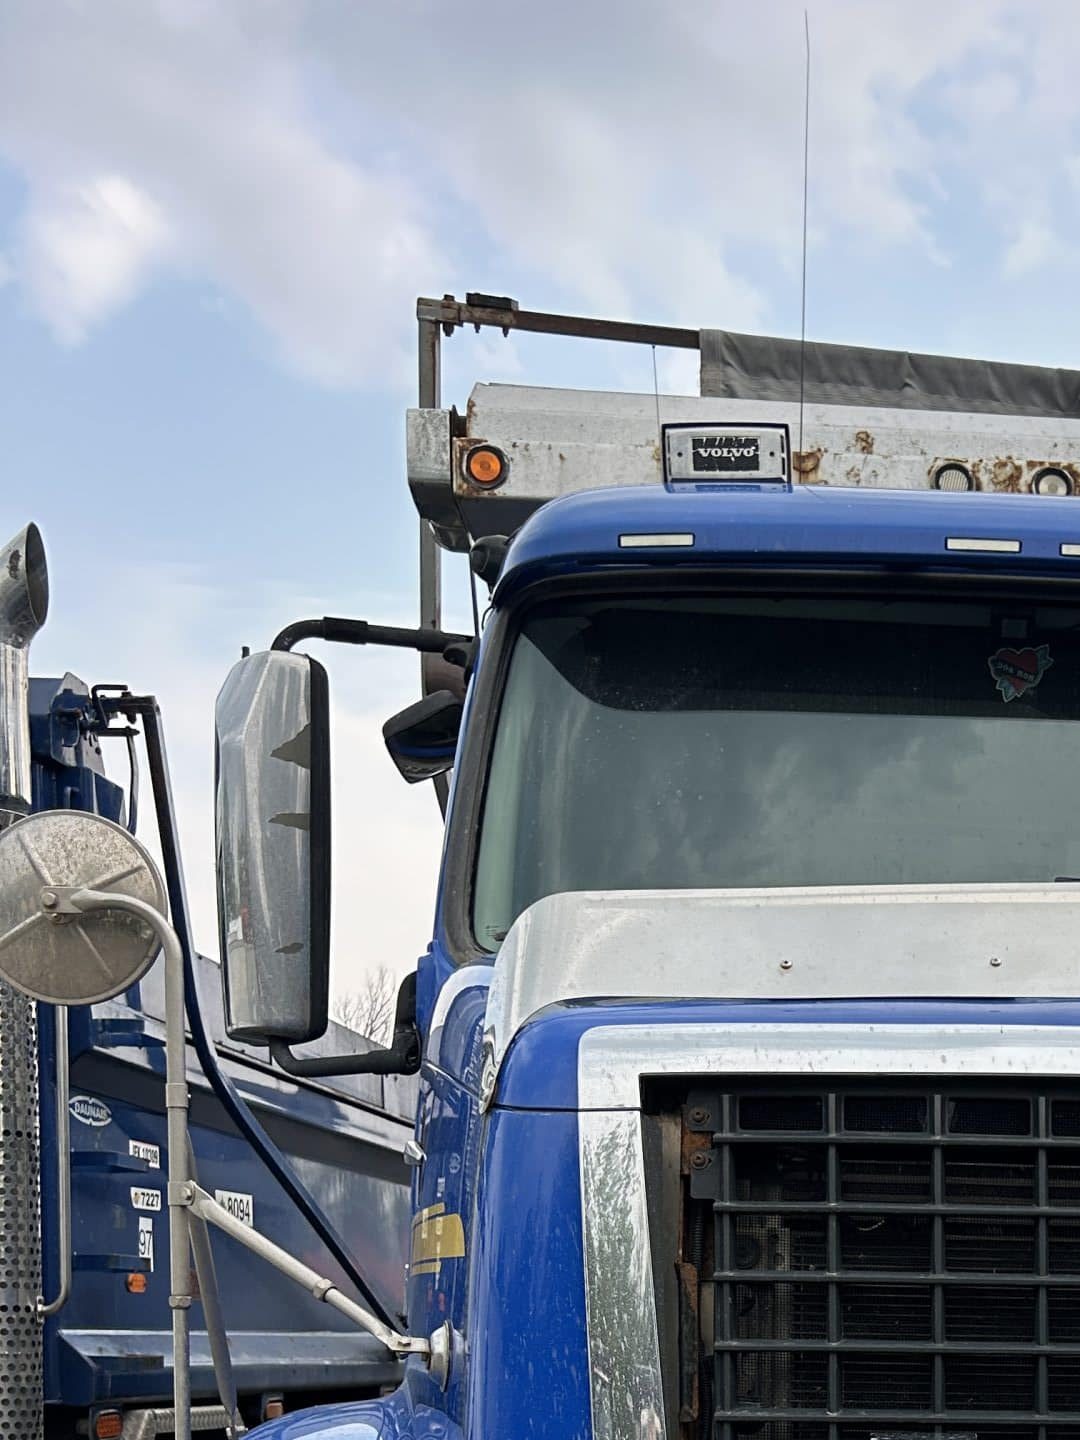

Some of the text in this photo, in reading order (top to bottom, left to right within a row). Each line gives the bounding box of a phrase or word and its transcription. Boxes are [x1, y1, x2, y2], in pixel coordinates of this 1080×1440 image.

[699, 447, 755, 458] VOLVO
[141, 1191, 160, 1209] 7227
[227, 1197, 250, 1222] 8094
